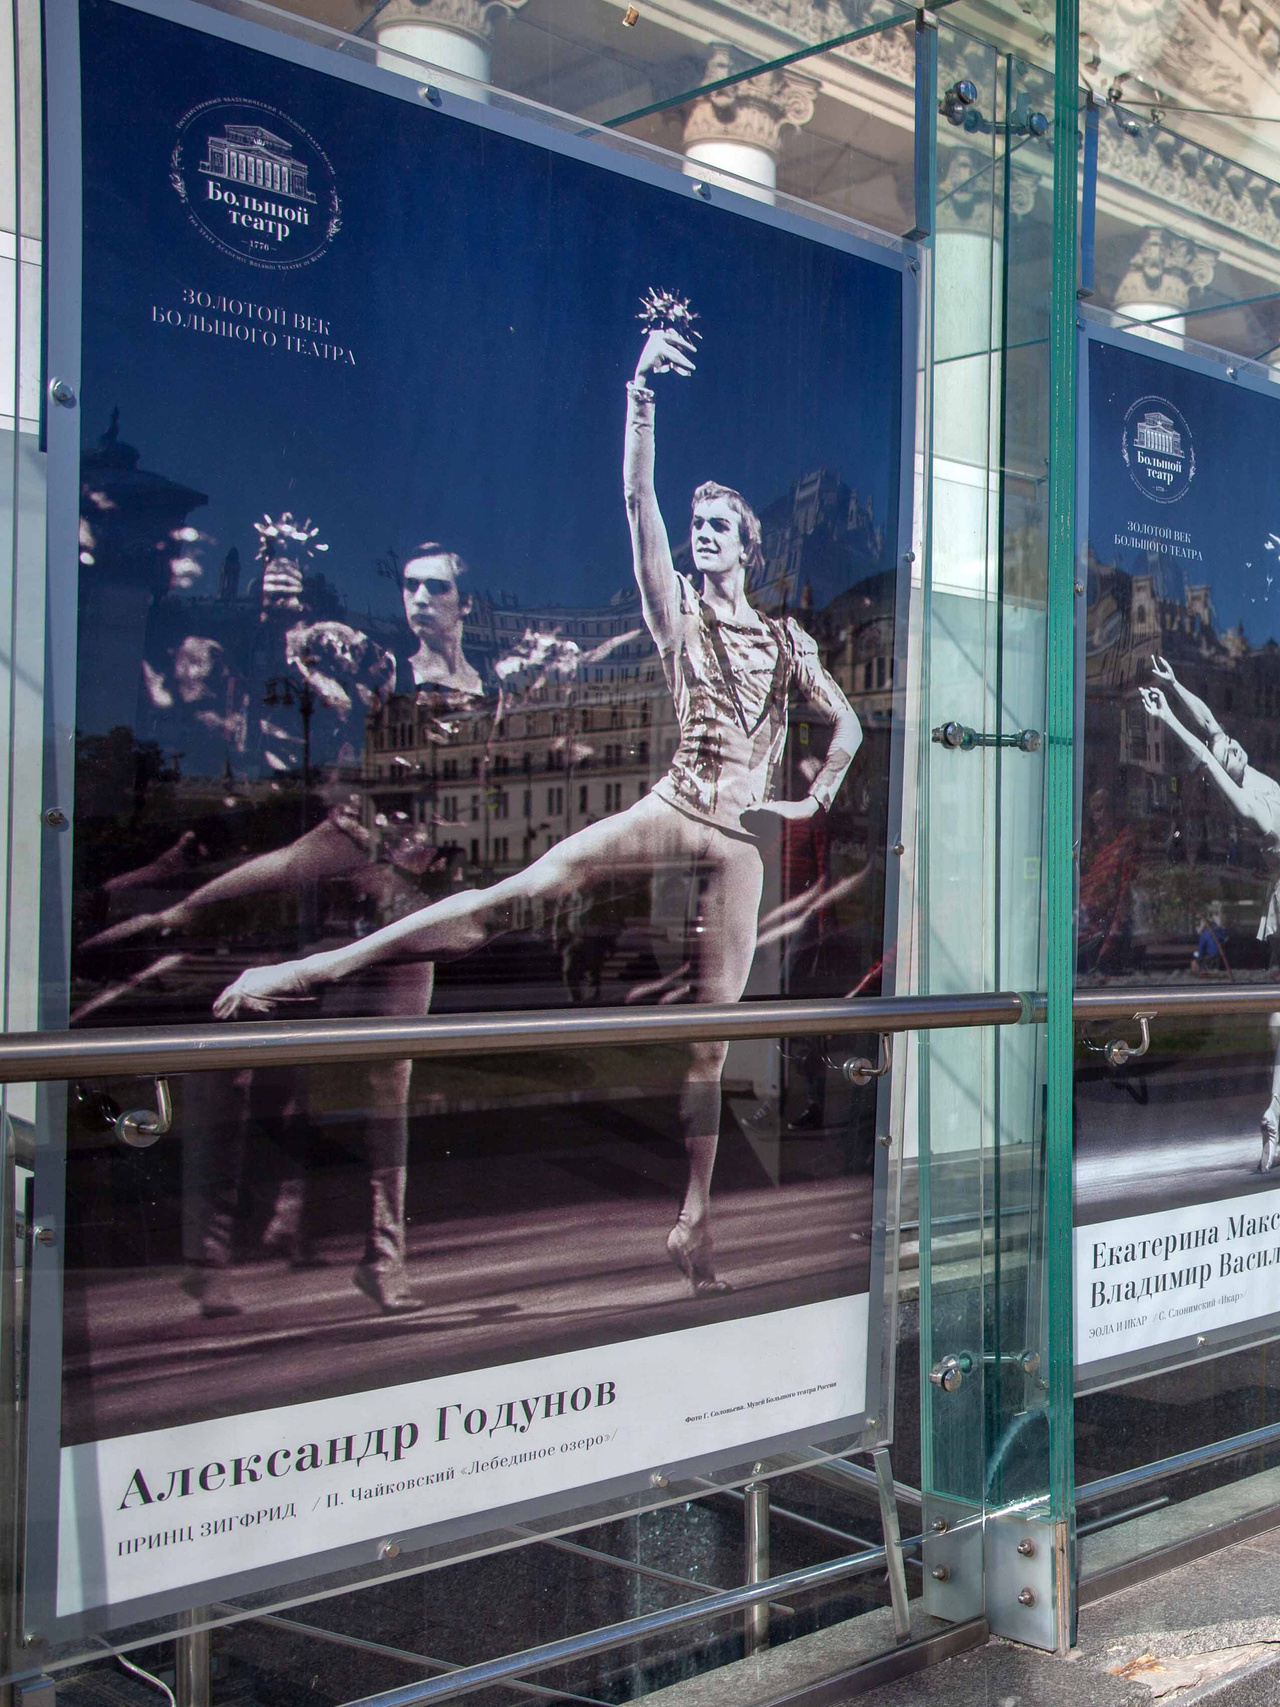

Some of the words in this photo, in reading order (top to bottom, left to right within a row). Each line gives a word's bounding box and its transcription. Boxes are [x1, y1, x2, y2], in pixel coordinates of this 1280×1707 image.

[207, 180, 310, 226] Большой
[228, 209, 290, 242] театр
[249, 240, 270, 251] 1776
[183, 288, 287, 326] ЗОЛОТОЙ
[294, 312, 331, 336] ВЕК
[152, 305, 277, 347] БОЛЬШОГО
[282, 333, 356, 365] ТЕАТРА
[1137, 450, 1182, 473] Большой
[1146, 467, 1174, 485] театр
[1114, 534, 1168, 554] БОЛЬШОГО
[1169, 544, 1203, 562] ТЕАТРА
[1127, 521, 1172, 540] ЗОЛОТОЙ
[1174, 531, 1191, 544] ВЕК
[1091, 1225, 1219, 1270] Екатерина
[1090, 1261, 1212, 1309] Владимир
[1088, 1323, 1115, 1339] ЭОЛА
[1116, 1320, 1123, 1332] И
[1124, 1315, 1148, 1329] ИКАР
[1168, 1298, 1216, 1318] Слонимский
[685, 1415, 702, 1423] Фото
[746, 1399, 765, 1409] Музей
[766, 1392, 796, 1404] Большого
[796, 1387, 817, 1397] театра
[116, 1421, 420, 1511] Александр
[434, 1380, 617, 1442] Годунов
[118, 1525, 194, 1556] ПРИНЦ
[200, 1502, 297, 1537] ЗИГФРИД
[326, 1493, 344, 1508] П.
[350, 1466, 456, 1501] Чайковский
[460, 1444, 556, 1476] «Лебединое
